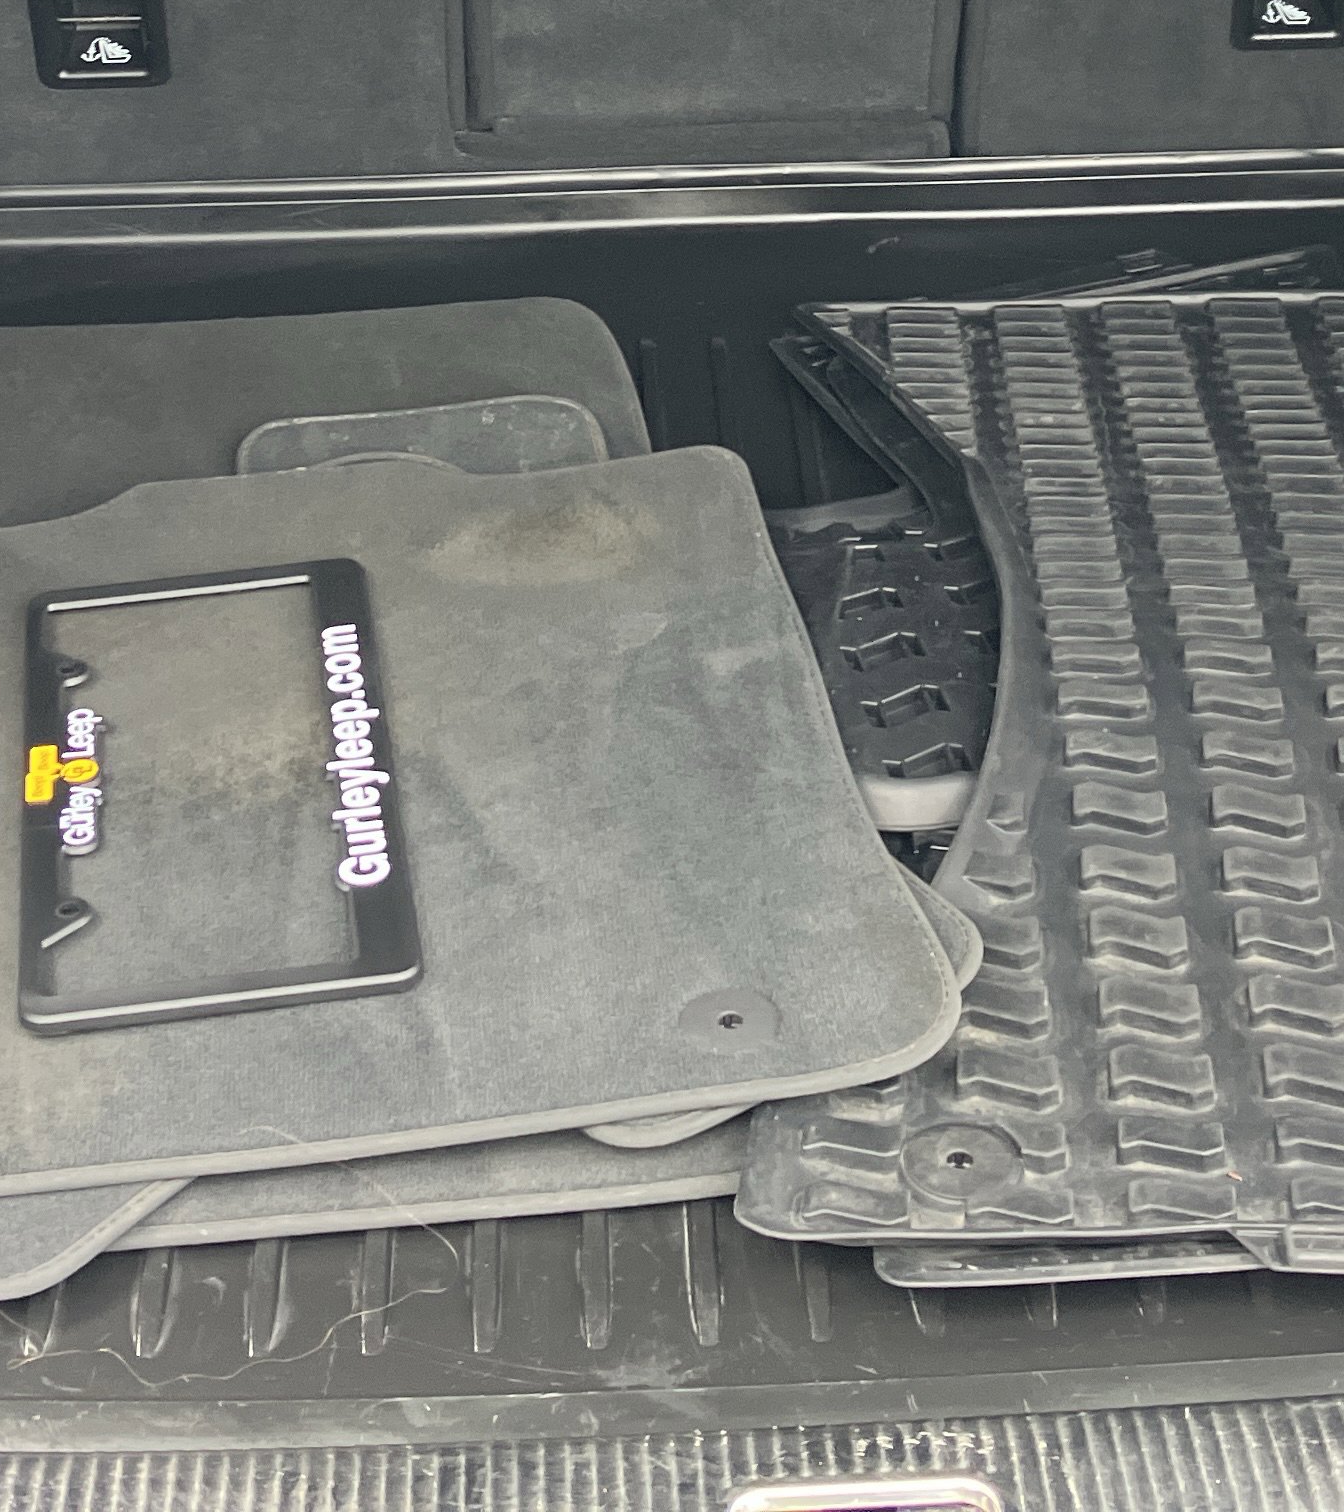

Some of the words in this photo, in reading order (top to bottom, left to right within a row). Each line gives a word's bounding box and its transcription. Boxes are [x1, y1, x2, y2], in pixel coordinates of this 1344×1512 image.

[60, 708, 103, 759] Leep
[321, 622, 391, 888] Gurleyleep.com
[60, 786, 103, 846] Gurley
